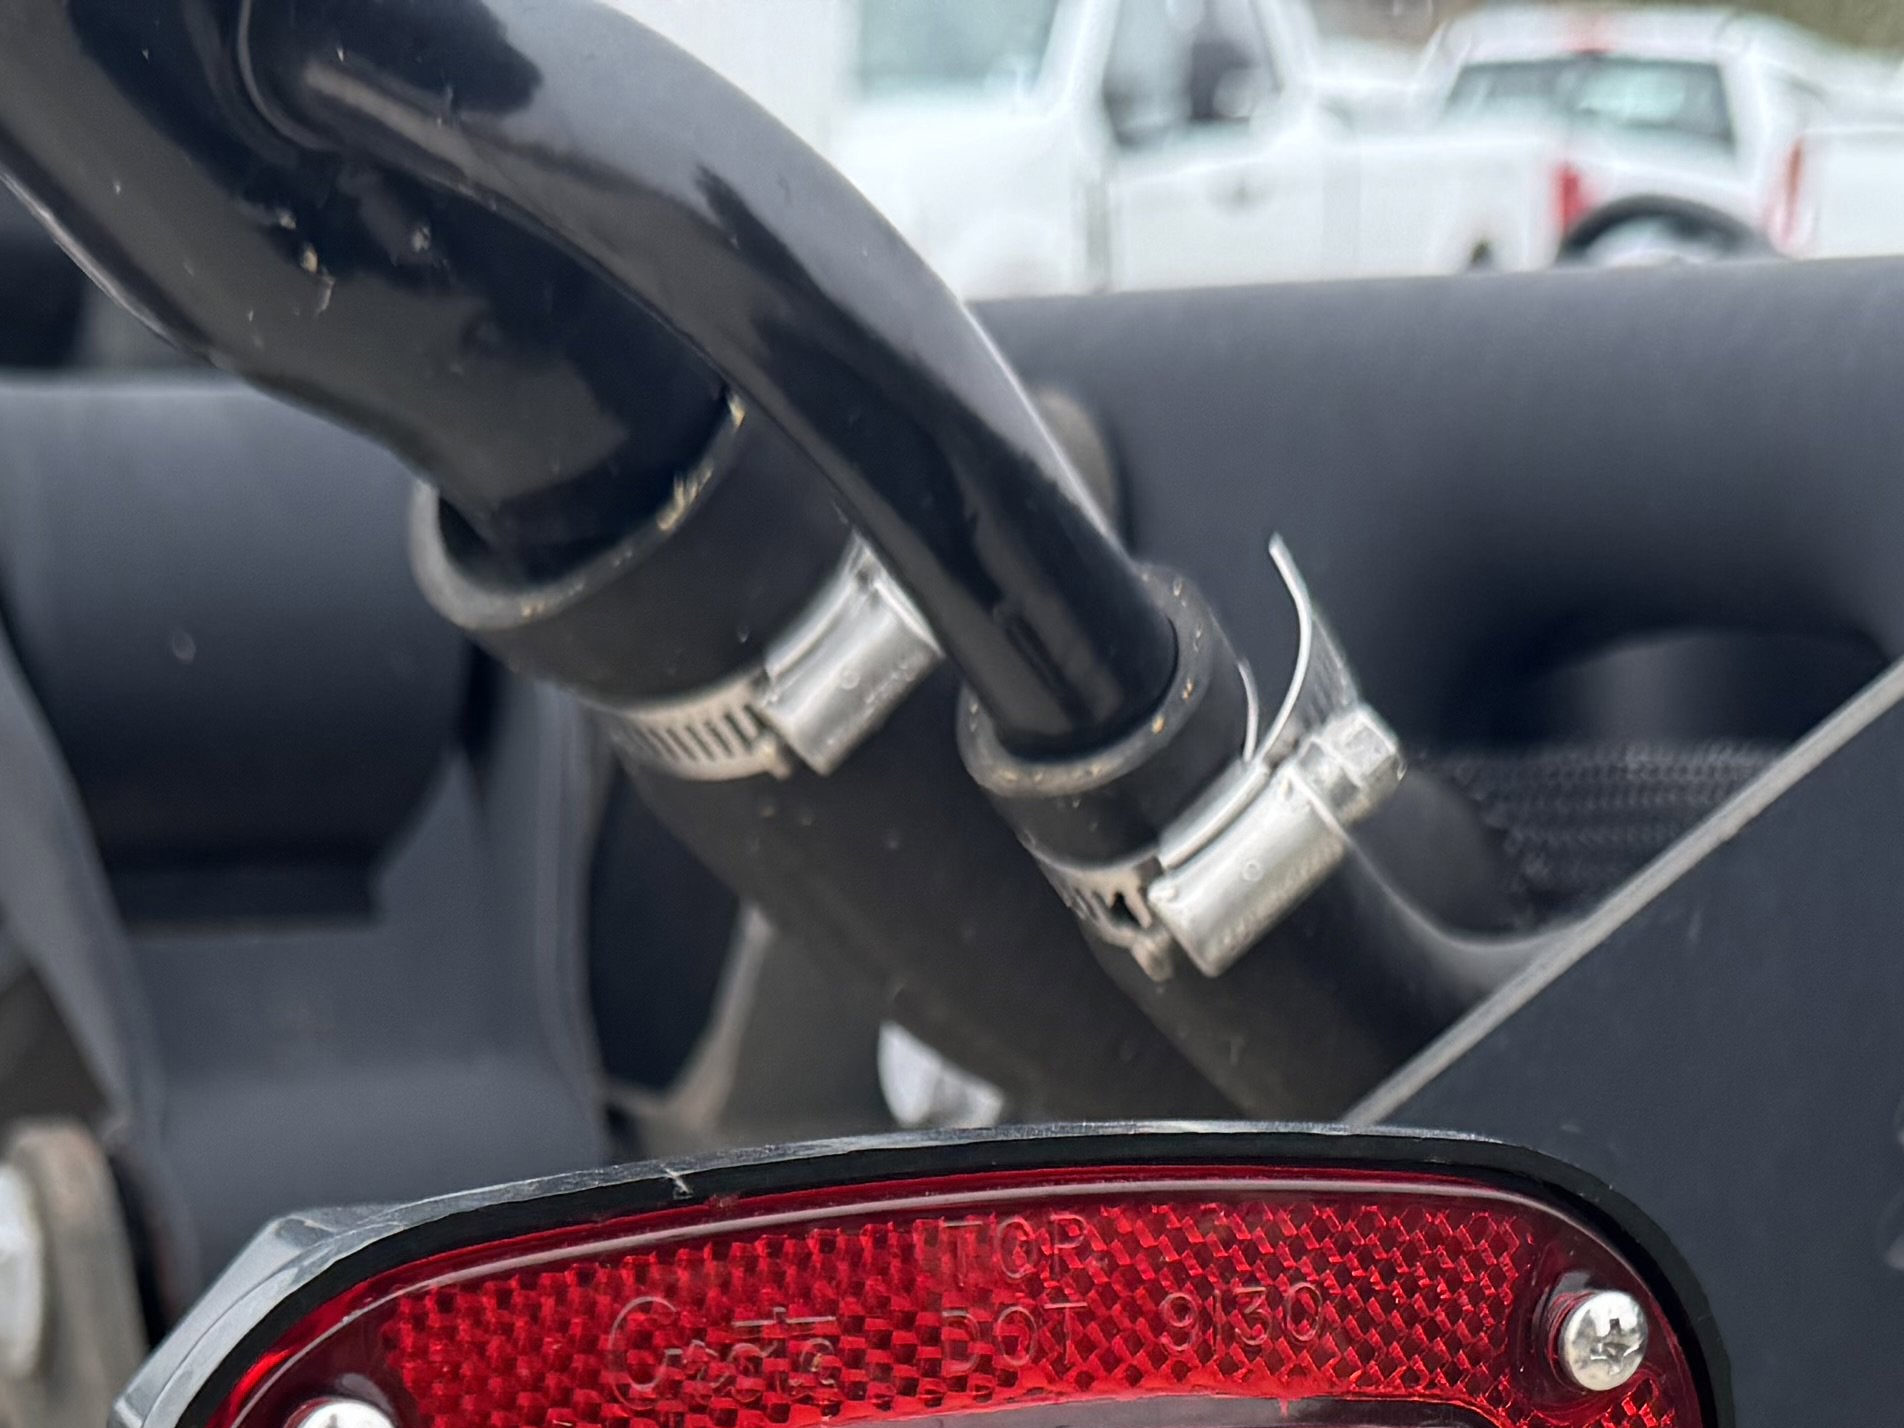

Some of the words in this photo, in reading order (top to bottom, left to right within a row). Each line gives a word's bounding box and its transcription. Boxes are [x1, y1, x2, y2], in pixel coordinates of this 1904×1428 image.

[942, 1212, 1088, 1291] TOP
[941, 1301, 1089, 1377] DOT
[1157, 1280, 1326, 1360] 9130
